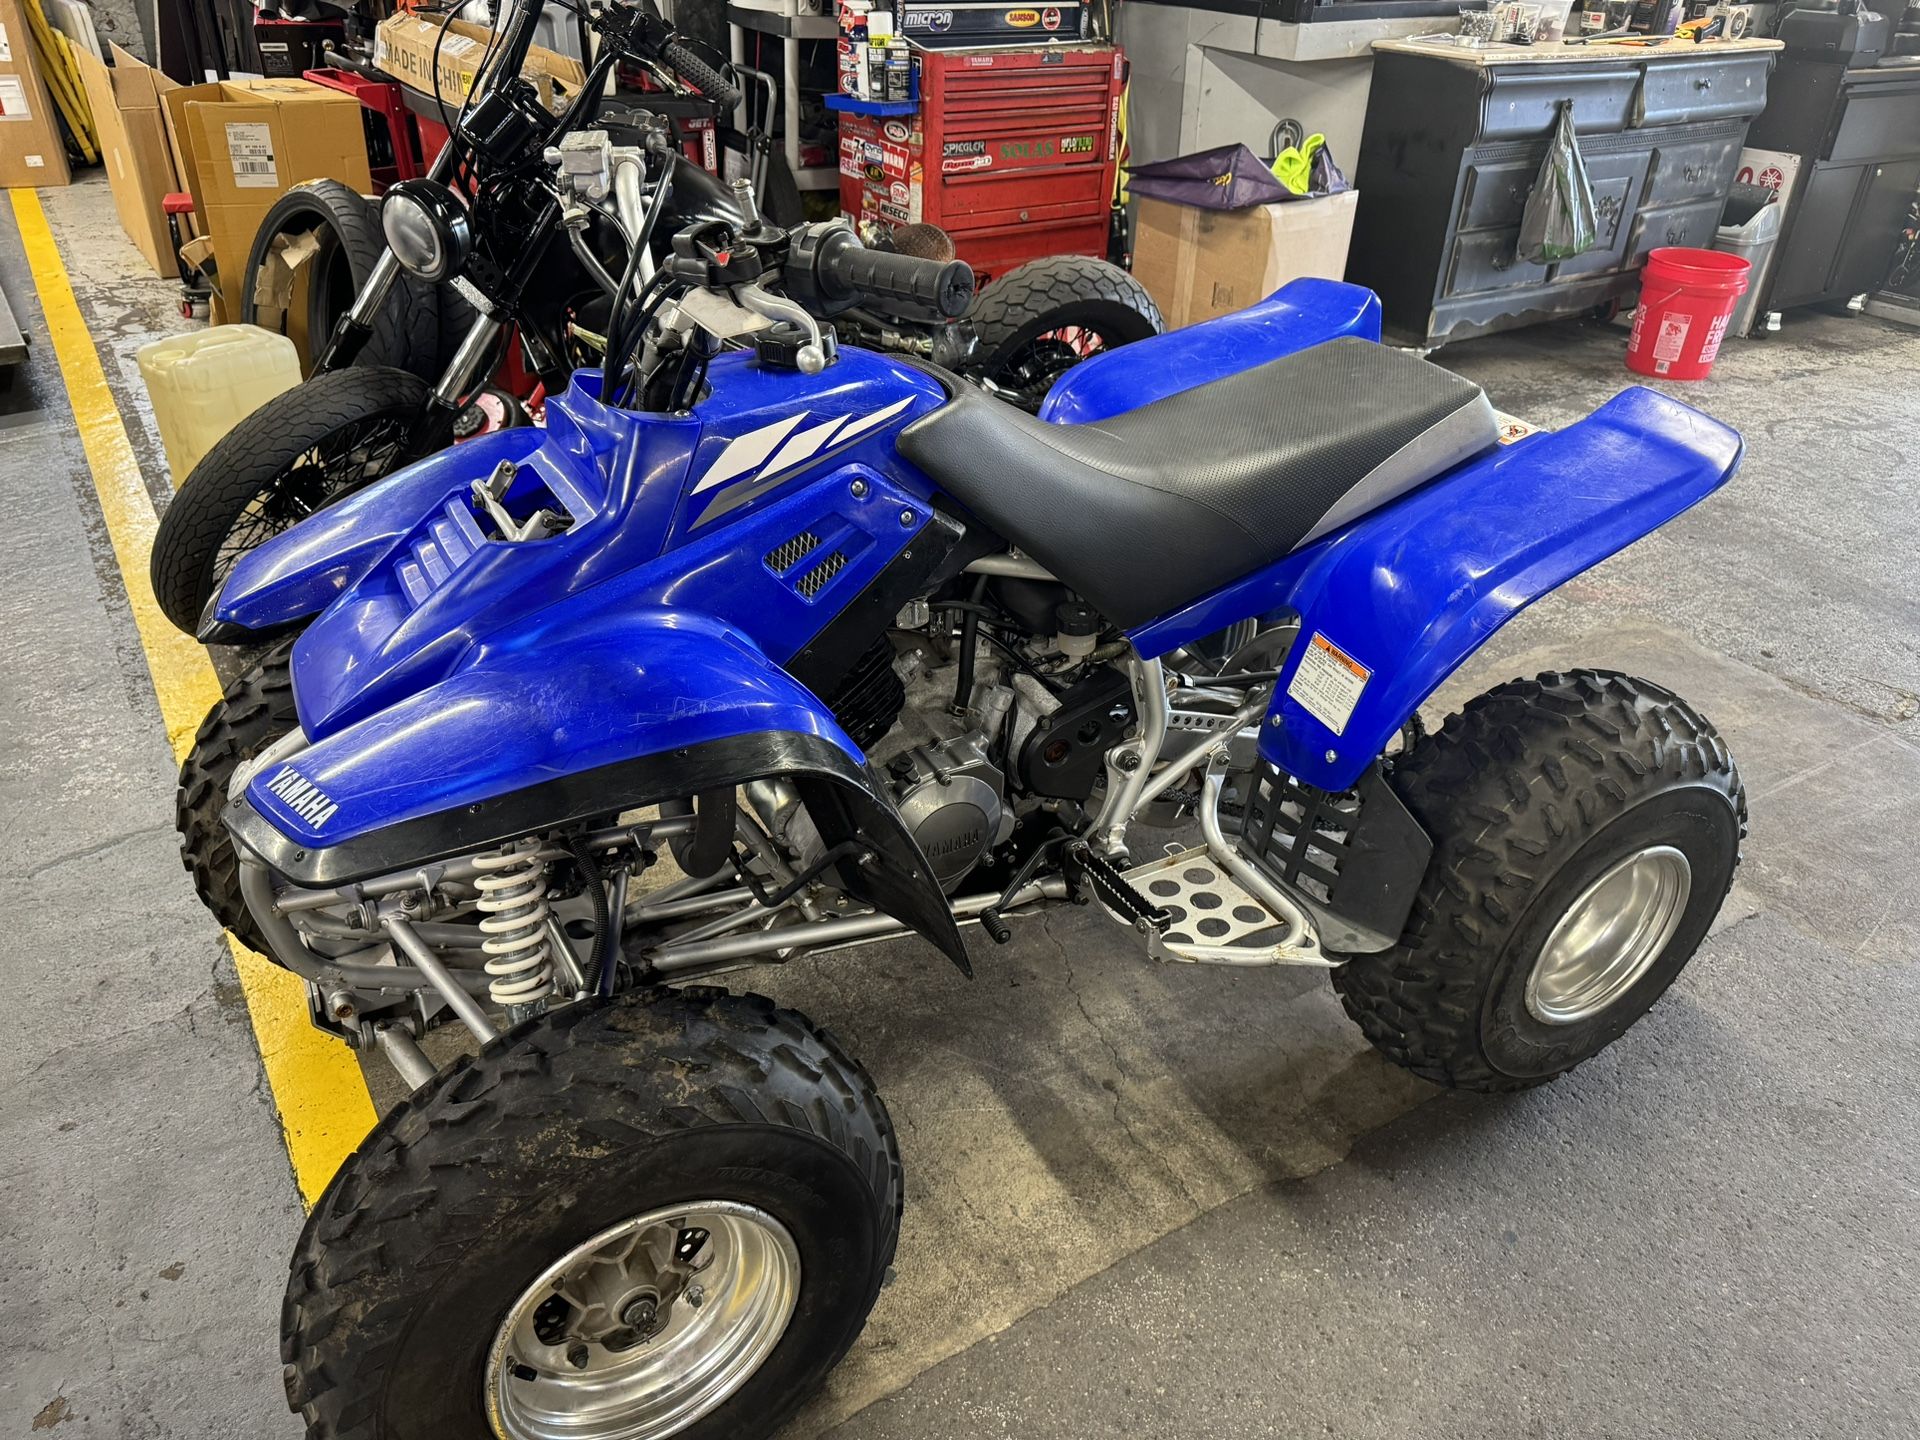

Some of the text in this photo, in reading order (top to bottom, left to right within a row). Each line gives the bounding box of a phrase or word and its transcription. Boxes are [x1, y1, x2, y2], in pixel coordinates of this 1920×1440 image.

[385, 40, 417, 75] MADE
[420, 57, 432, 82] IN
[437, 65, 477, 102] CHIN
[1000, 142, 1054, 160] SOLAS
[1331, 649, 1353, 668] WARNING
[265, 765, 339, 830] YAMAHA
[922, 829, 980, 858] YAMAHA
